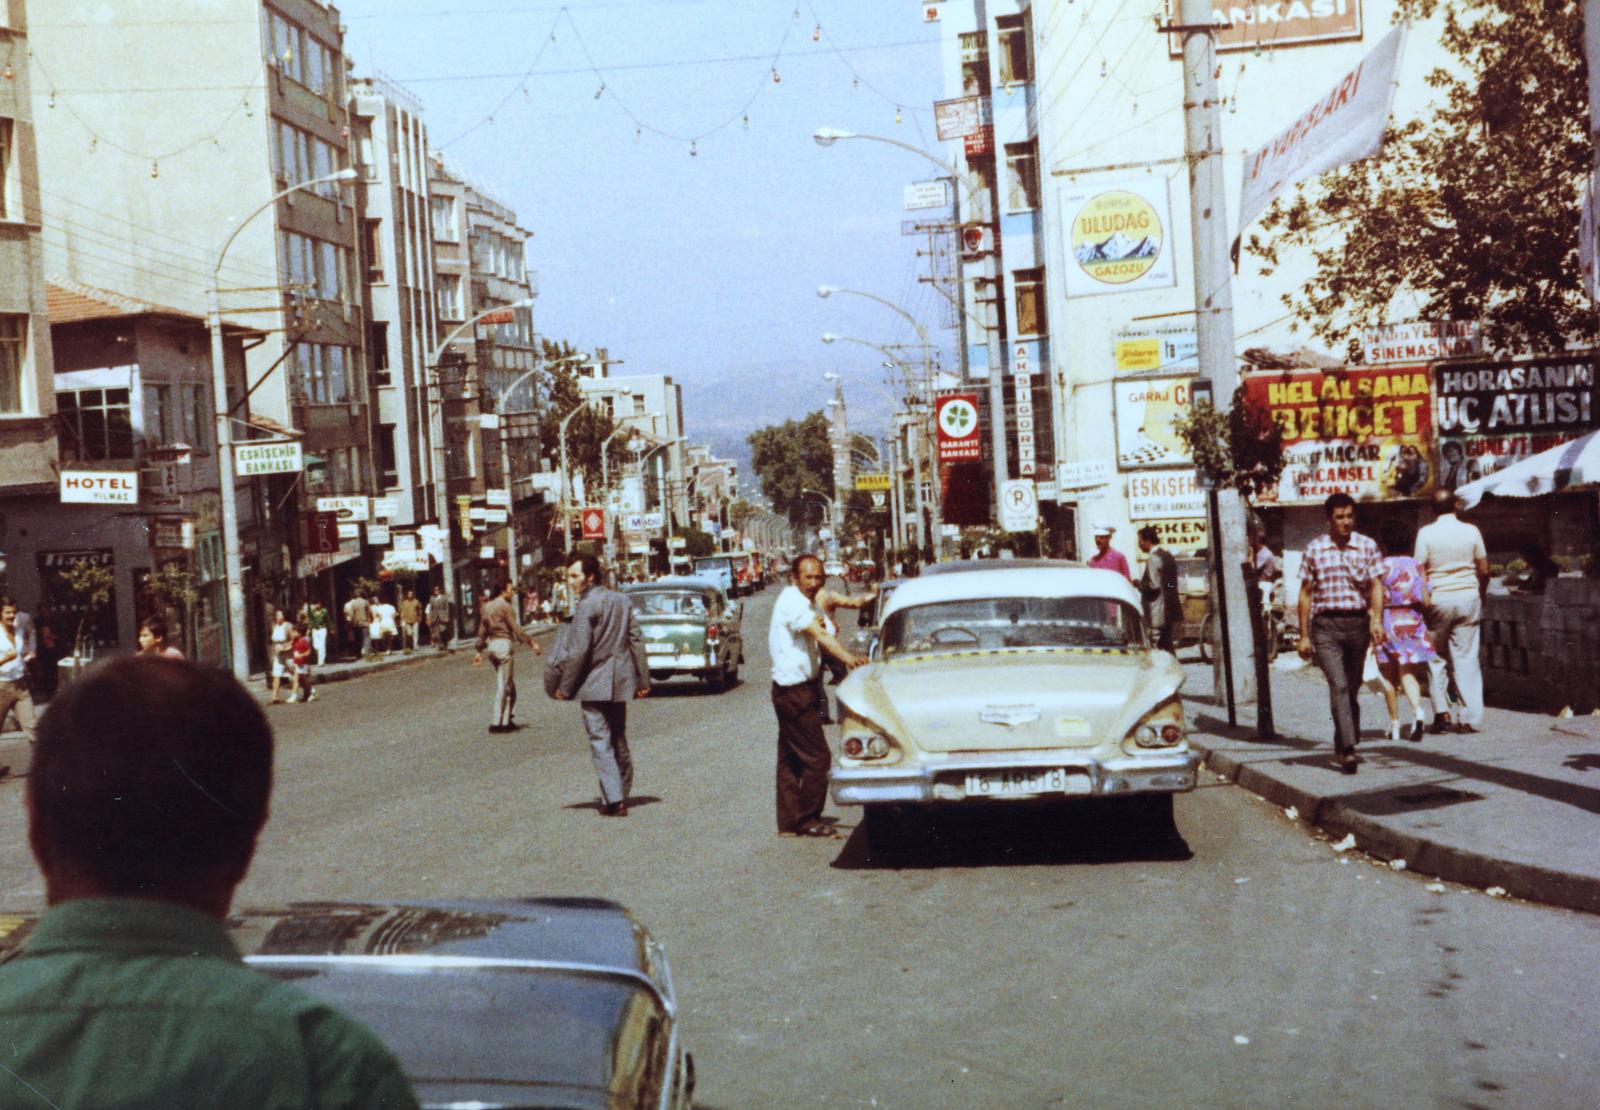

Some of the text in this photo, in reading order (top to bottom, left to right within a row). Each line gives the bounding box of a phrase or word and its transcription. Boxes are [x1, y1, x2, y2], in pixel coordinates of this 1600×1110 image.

[1211, 0, 1347, 24] ANKASI
[1128, 391, 1170, 403] GARAJ
[1269, 374, 1429, 405] HELAL SANA
[1488, 391, 1591, 428] ATLISI
[1272, 400, 1424, 443] BEHÇET
[941, 449, 979, 458] BANKASI
[1324, 444, 1381, 463] NACAR
[246, 460, 293, 473] BANKASI
[1315, 466, 1376, 483] CANSEL
[66, 478, 132, 489] HOTEL
[1132, 477, 1200, 497] ESKİŞEH
[1014, 490, 1024, 506] P
[1146, 521, 1206, 535] SKEN
